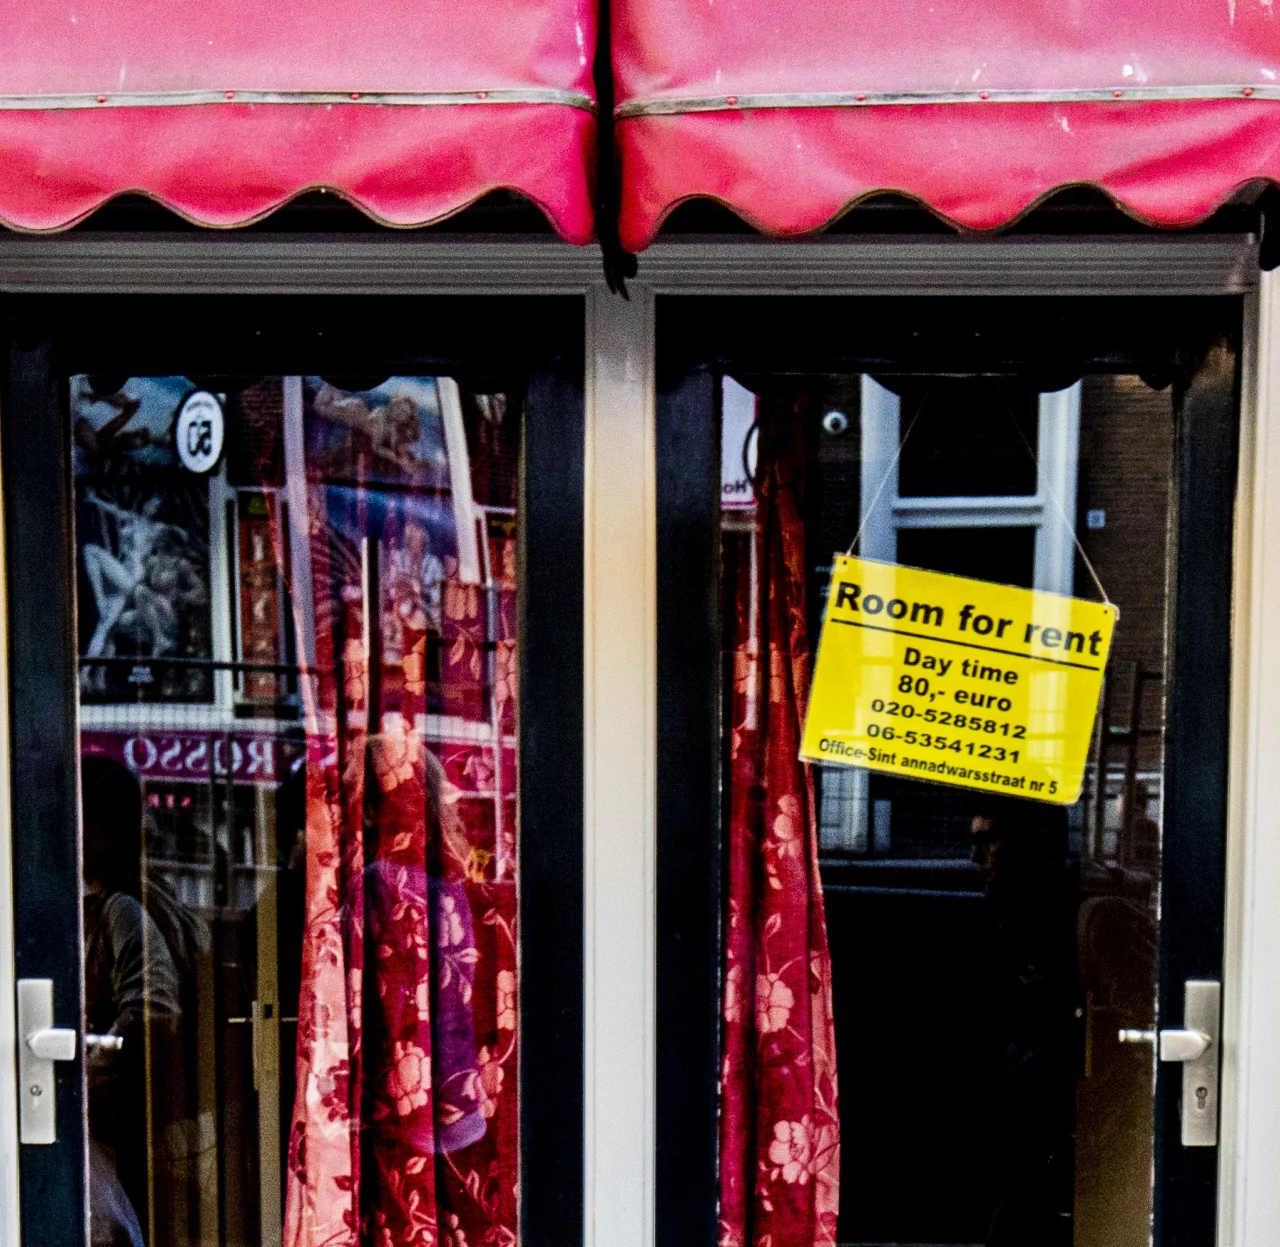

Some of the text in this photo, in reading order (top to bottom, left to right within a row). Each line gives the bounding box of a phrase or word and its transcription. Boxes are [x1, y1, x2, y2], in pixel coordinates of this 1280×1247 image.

[835, 581, 1102, 657] Room for rent
[903, 647, 1019, 685] Day time
[897, 674, 1012, 712] 80,- euro
[871, 699, 1027, 740] 020-5285812
[866, 723, 1020, 763] 06-53541231
[900, 756, 1026, 790] annadwarsstraat
[1029, 779, 1045, 792] nr
[1048, 780, 1058, 795] 5
